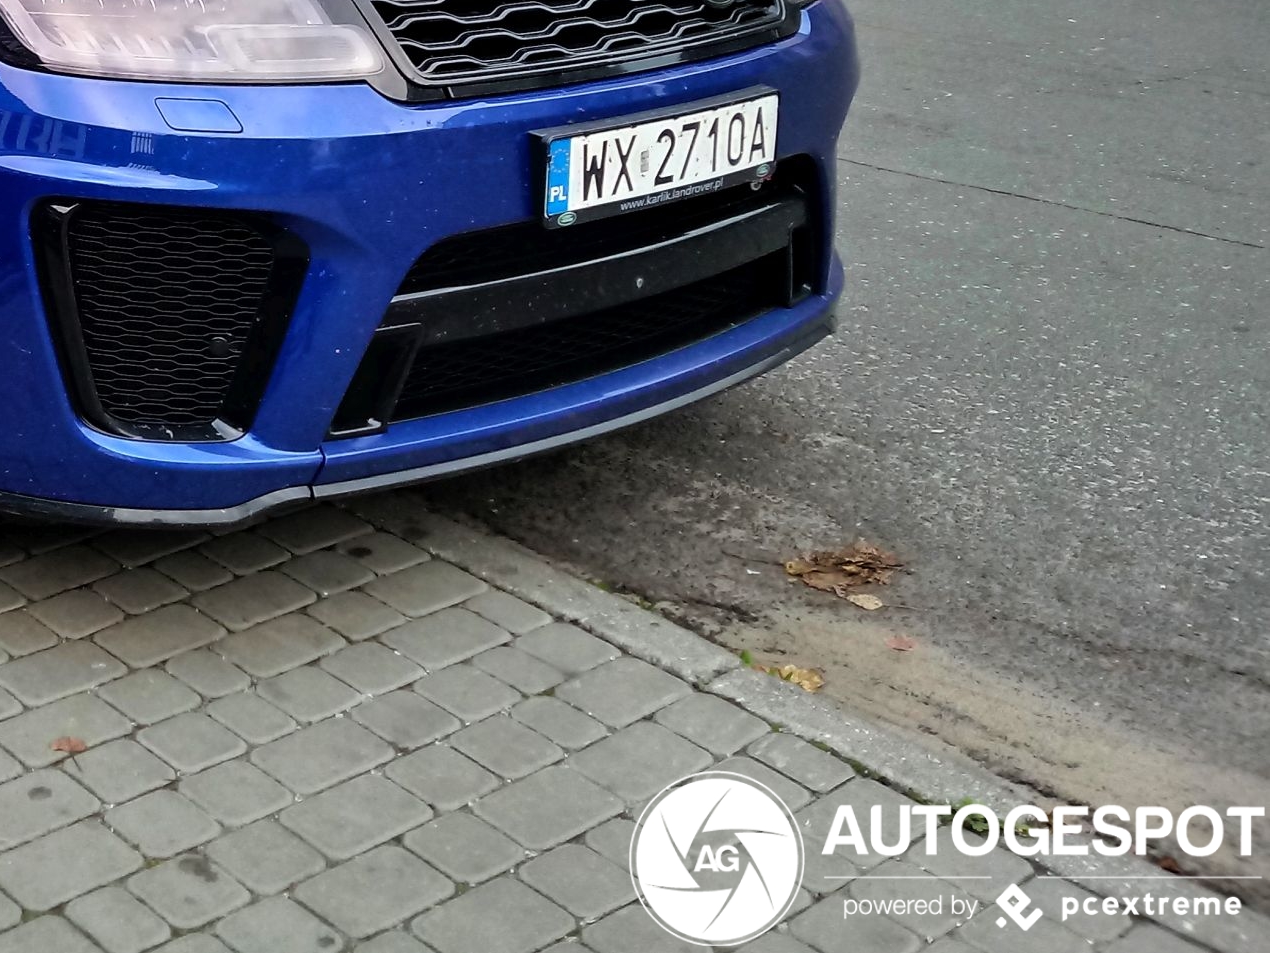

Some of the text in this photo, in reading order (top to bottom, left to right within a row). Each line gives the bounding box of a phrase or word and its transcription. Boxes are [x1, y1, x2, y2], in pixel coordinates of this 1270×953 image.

[582, 106, 767, 202] WX 2710A
[549, 184, 567, 203] PL
[619, 177, 725, 211] www.karlik.landrover.pl
